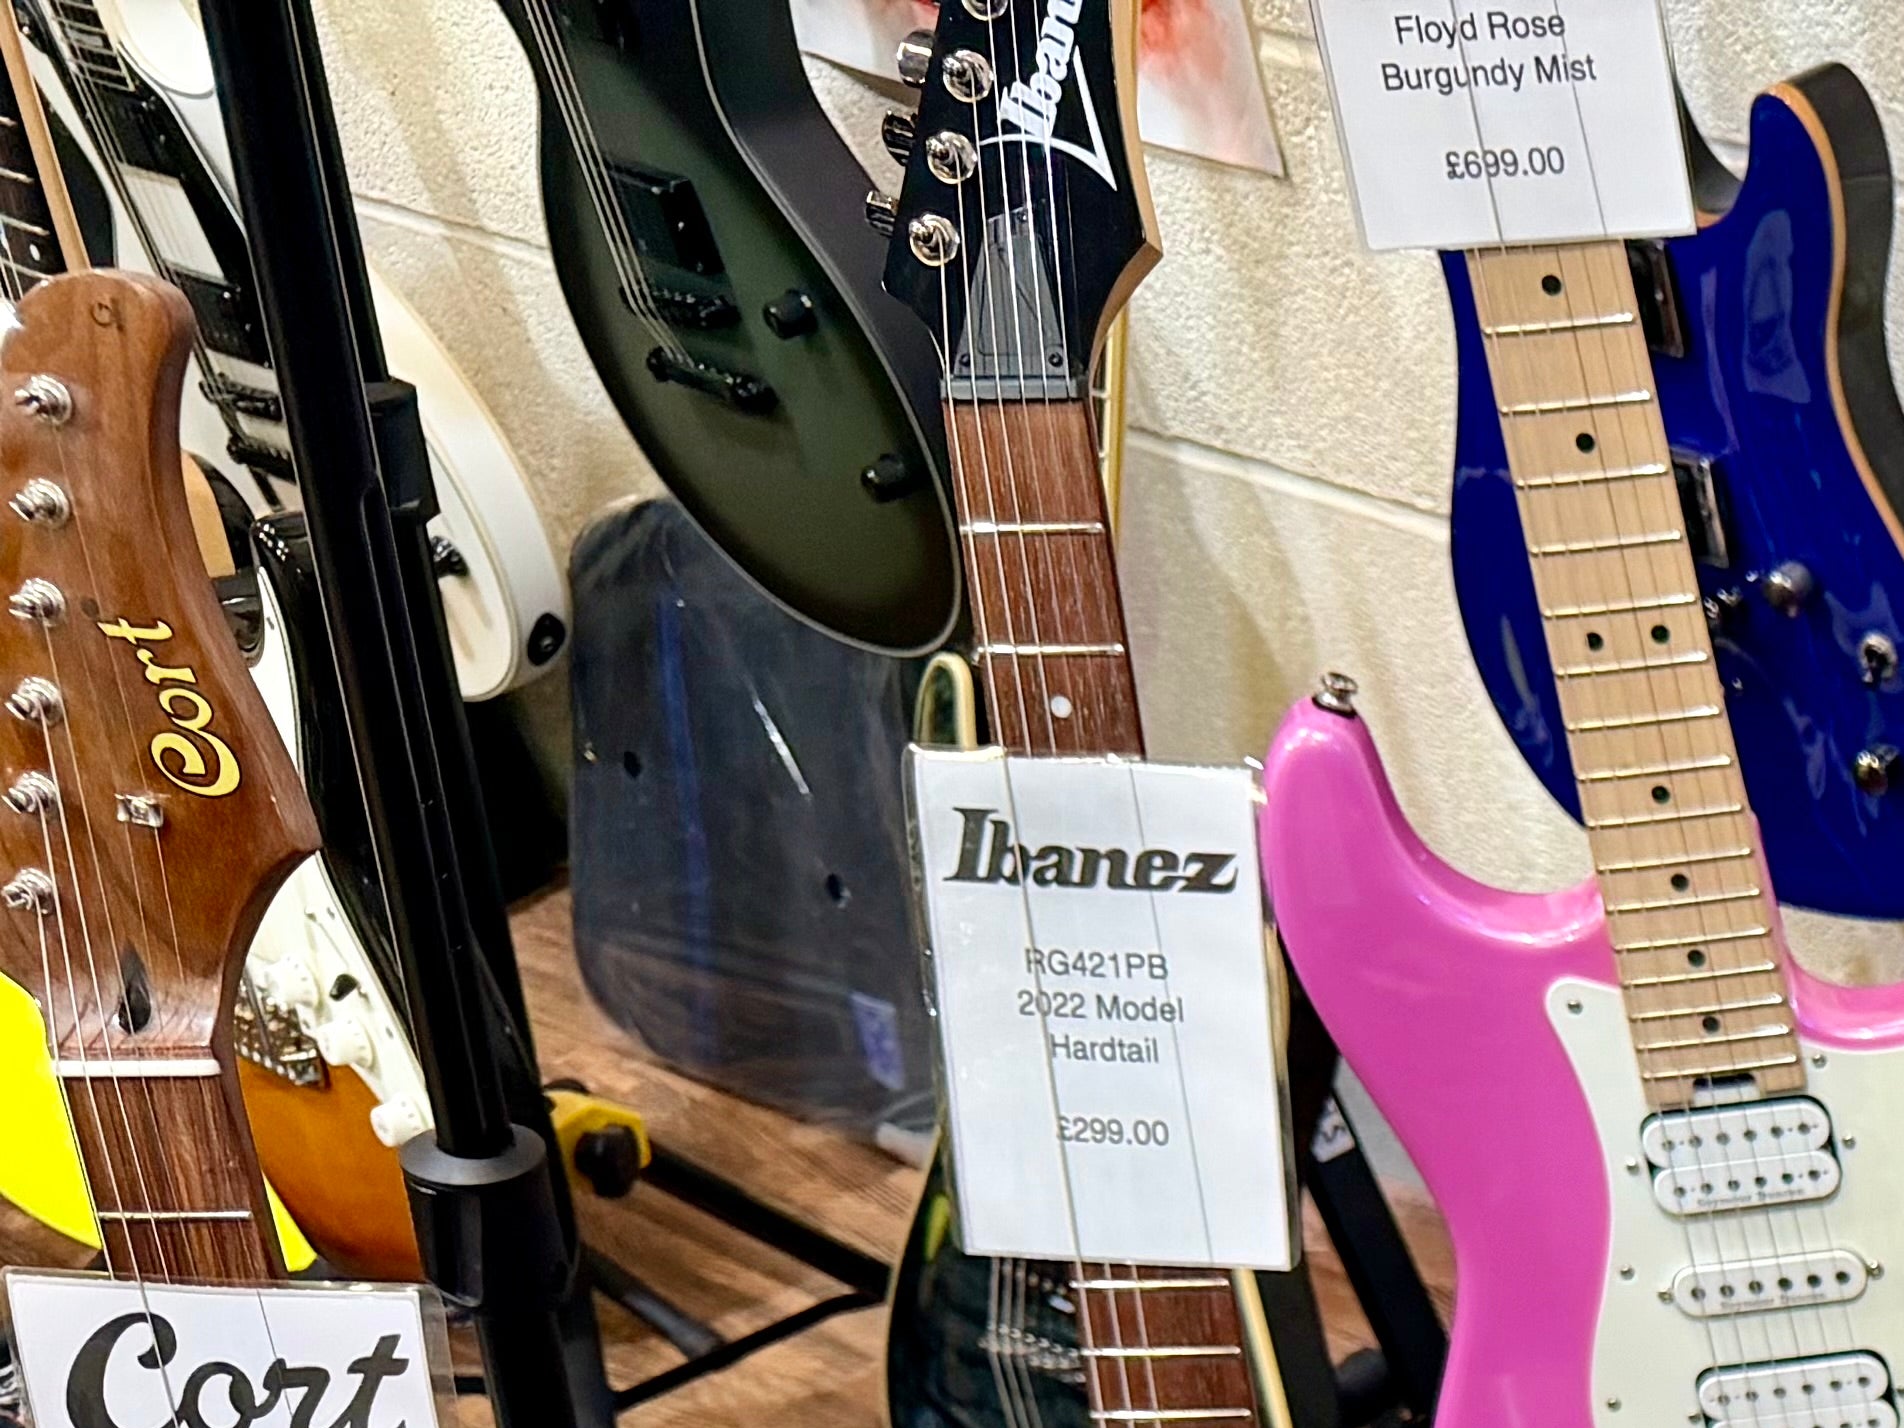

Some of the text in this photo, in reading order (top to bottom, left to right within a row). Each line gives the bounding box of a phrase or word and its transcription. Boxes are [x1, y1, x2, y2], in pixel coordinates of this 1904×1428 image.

[1394, 11, 1566, 49] Floyd Rose
[1000, 0, 1083, 137] Iban
[1381, 54, 1597, 96] Burgundy Mist
[1445, 146, 1566, 181] £699.00
[97, 617, 241, 797] Cort
[943, 807, 1239, 894] Ibanez
[1025, 948, 1169, 980] RG421PB
[1017, 990, 1184, 1023] 2022 Model
[1049, 1034, 1160, 1063] Hardtail
[1057, 1115, 1170, 1146] £299.00
